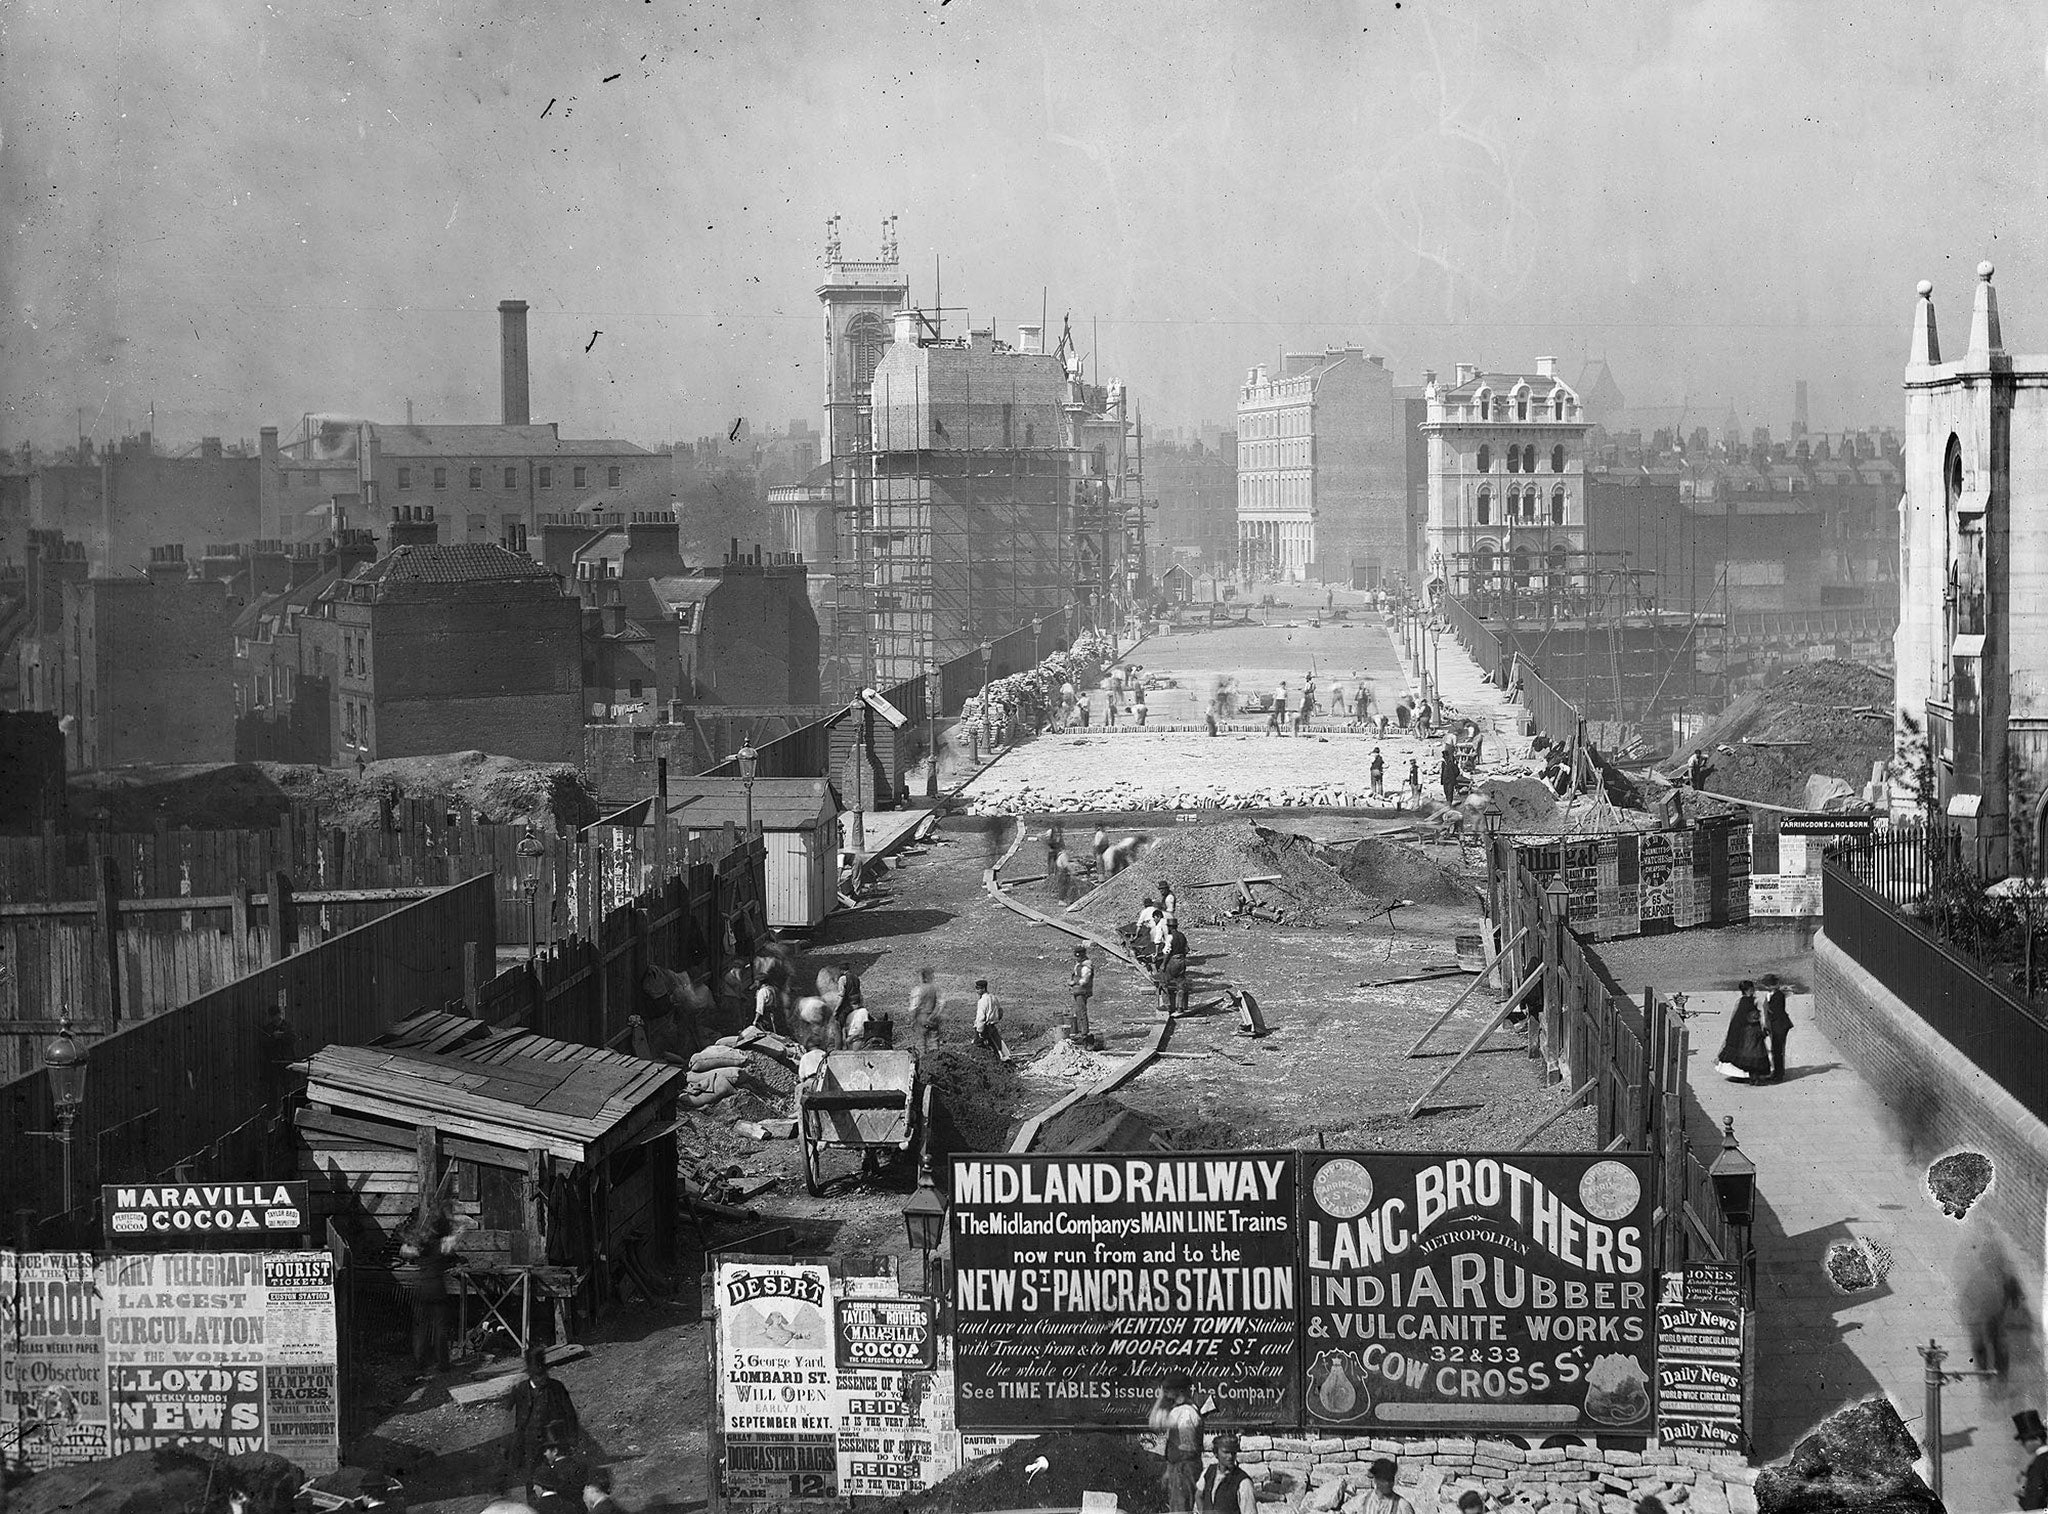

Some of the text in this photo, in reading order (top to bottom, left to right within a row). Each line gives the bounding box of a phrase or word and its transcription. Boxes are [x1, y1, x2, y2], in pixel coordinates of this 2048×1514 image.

[1651, 894, 1662, 905] 65
[1640, 903, 1674, 919] CHEAPSIDE
[954, 1160, 1286, 1204] MIDLAND RAILWAY
[1318, 1162, 1367, 1184] OPPOSITE
[117, 1186, 292, 1208] MARAVILLA
[1320, 1196, 1366, 1215] STATION
[152, 1209, 260, 1231] COCOA
[957, 1212, 989, 1235] The
[989, 1212, 1053, 1235] Midland
[1141, 1211, 1184, 1234] MAIN
[1188, 1210, 1228, 1233] LINE
[1228, 1209, 1288, 1233] Trains
[1415, 1158, 1643, 1275] BROTHERS
[1014, 1240, 1241, 1264] now run from and to the
[1418, 1229, 1530, 1257] METROPOLITAN
[106, 1254, 264, 1287] DAILY TELEGRAPH
[265, 1262, 330, 1278] TOURIST
[270, 1278, 327, 1286] TICKETS.
[957, 1269, 1017, 1312] NEW
[1053, 1268, 1170, 1312] PANCRAS
[1175, 1266, 1293, 1312] STATION
[1310, 1252, 1646, 1310] INDIA RUBBER
[298, 1292, 328, 1300] STATION
[730, 1276, 823, 1305] DESERT
[118, 1293, 247, 1309] LARGEST
[841, 1309, 876, 1324] TAYLOR
[957, 1318, 990, 1335] and
[989, 1322, 1016, 1336] are
[1016, 1318, 1035, 1335] in
[1034, 1318, 1104, 1335] Connection
[1110, 1317, 1188, 1335] KENTISH
[1246, 1315, 1295, 1334] Station
[1659, 1310, 1737, 1331] Daily News
[106, 1316, 264, 1345] CIRCULATION
[851, 1326, 921, 1341] MARAVILLA
[1307, 1313, 1645, 1342] & VULCANITE WORKS
[959, 1339, 990, 1356] with
[990, 1339, 1040, 1359] Trains
[1042, 1340, 1075, 1358] from
[1077, 1344, 1089, 1356] &
[1089, 1341, 1106, 1356] to
[1108, 1338, 1224, 1356] MOORGATE
[1260, 1338, 1295, 1355] and
[1699, 1335, 1740, 1346] CIRCULATION
[107, 1352, 264, 1363] IN THE WORLD
[850, 1342, 920, 1358] COCOA
[1430, 1346, 1521, 1363] 32 & 33
[31, 1360, 101, 1382] Observer
[734, 1354, 744, 1370] 3
[747, 1354, 790, 1369] George
[986, 1360, 1011, 1377] the
[1015, 1360, 1057, 1377] whole
[1062, 1362, 1086, 1383] of
[1089, 1359, 1118, 1377] the
[1232, 1360, 1284, 1383] System
[1362, 1343, 1429, 1390] COW
[1435, 1361, 1551, 1398] CROSS
[111, 1369, 259, 1392] LLOYD'S
[267, 1375, 333, 1388] HAMPTON
[729, 1370, 831, 1384] LOMBARD ST.
[836, 1376, 893, 1391] ESSENCE OF
[1660, 1367, 1739, 1388] Daily News
[145, 1394, 186, 1402] WEEKLY
[270, 1388, 331, 1399] RACES.
[961, 1381, 995, 1399] See
[997, 1381, 1041, 1399] TIME
[1045, 1381, 1111, 1399] TABLES
[1217, 1382, 1286, 1405] Company
[1700, 1392, 1741, 1402] CIRCULATION
[112, 1402, 260, 1430] NEWS
[755, 1404, 790, 1413] EARLY
[731, 1416, 833, 1429] SEPTEMBER NEXT.
[841, 1416, 850, 1426] IT
[854, 1416, 862, 1426] IS
[866, 1416, 880, 1427] THE
[885, 1417, 904, 1427] VERY
[726, 1432, 834, 1442] GREAT NORTHERN RAILWAY
[964, 1436, 997, 1445] CAUTION
[1660, 1422, 1739, 1444] Daily News
[838, 1438, 932, 1455] ESSENCE OF COFFEE
[726, 1446, 837, 1471] DONCASTER RACES
[728, 1487, 767, 1498] FARE
[844, 1479, 906, 1490] IT IS THE VERY
